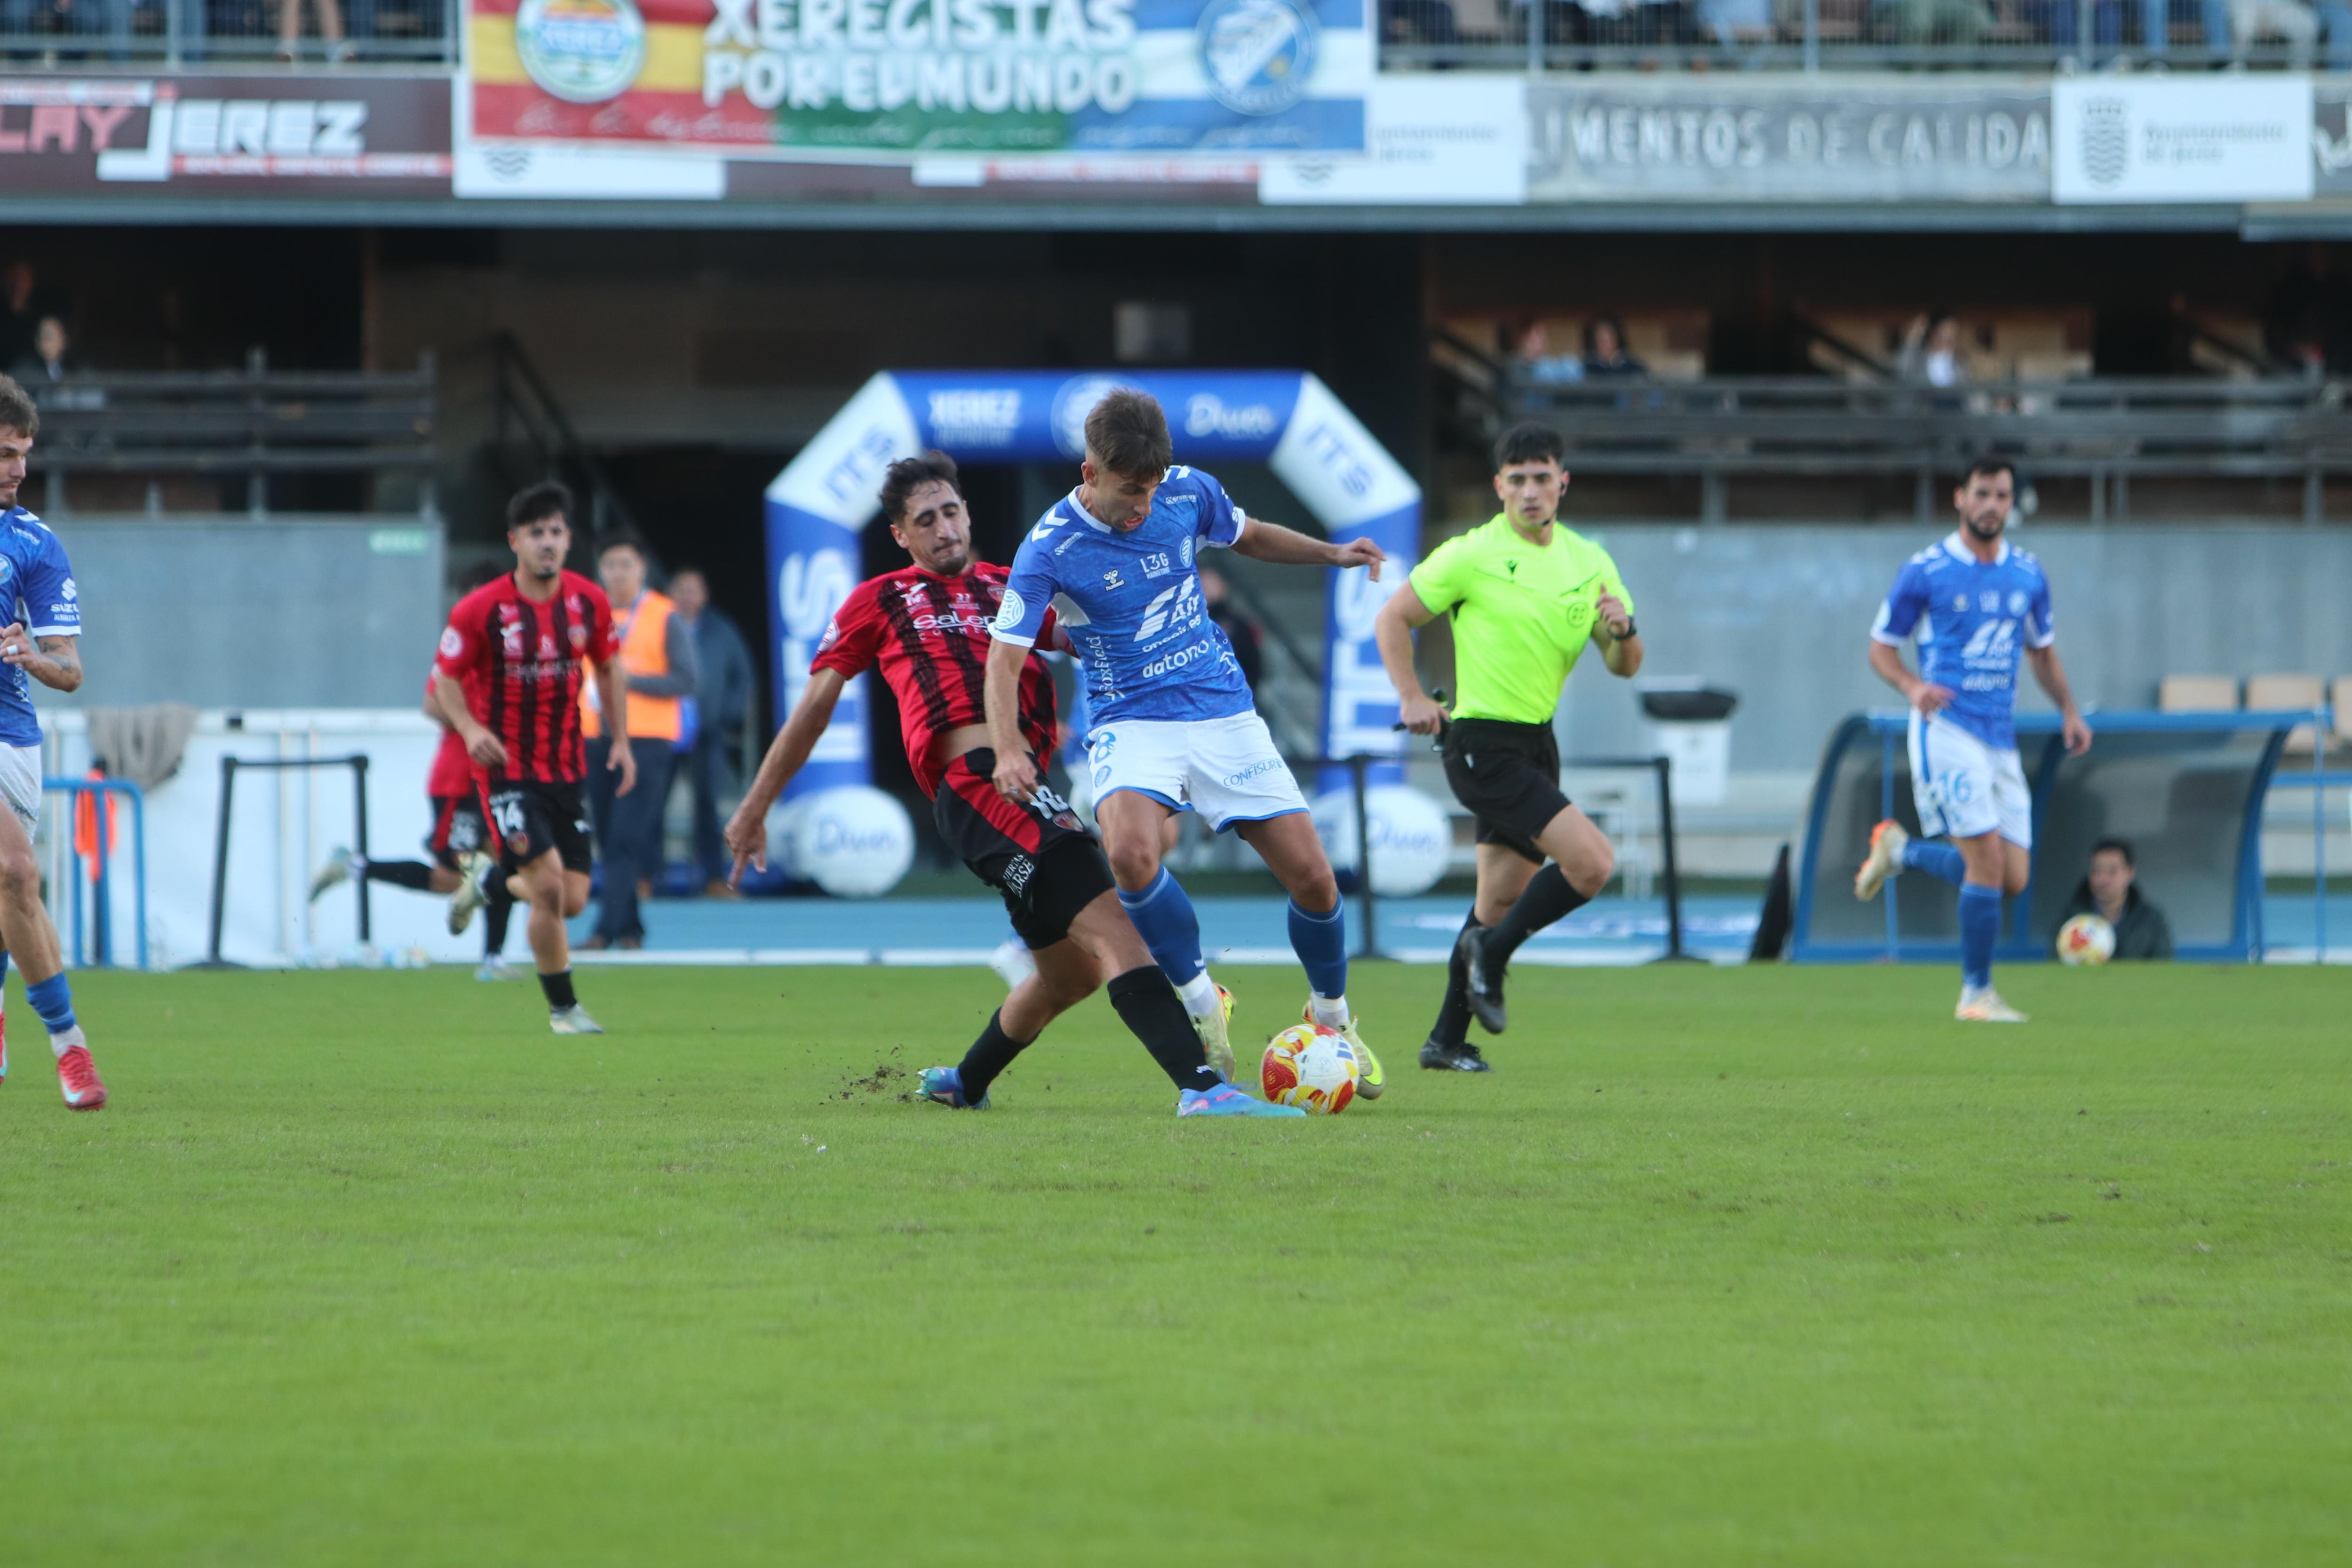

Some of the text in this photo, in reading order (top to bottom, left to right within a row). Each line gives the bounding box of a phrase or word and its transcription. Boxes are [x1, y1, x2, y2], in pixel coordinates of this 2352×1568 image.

[703, 50, 831, 110] POR
[916, 51, 1134, 114] MUNDO
[96, 82, 369, 182] JEREZ
[1786, 109, 1849, 166] DE
[1867, 109, 2050, 169] CALIDA
[1142, 639, 1209, 678] datono
[1094, 731, 1117, 764] 8
[1940, 772, 1972, 801] 16
[491, 800, 525, 837] 14
